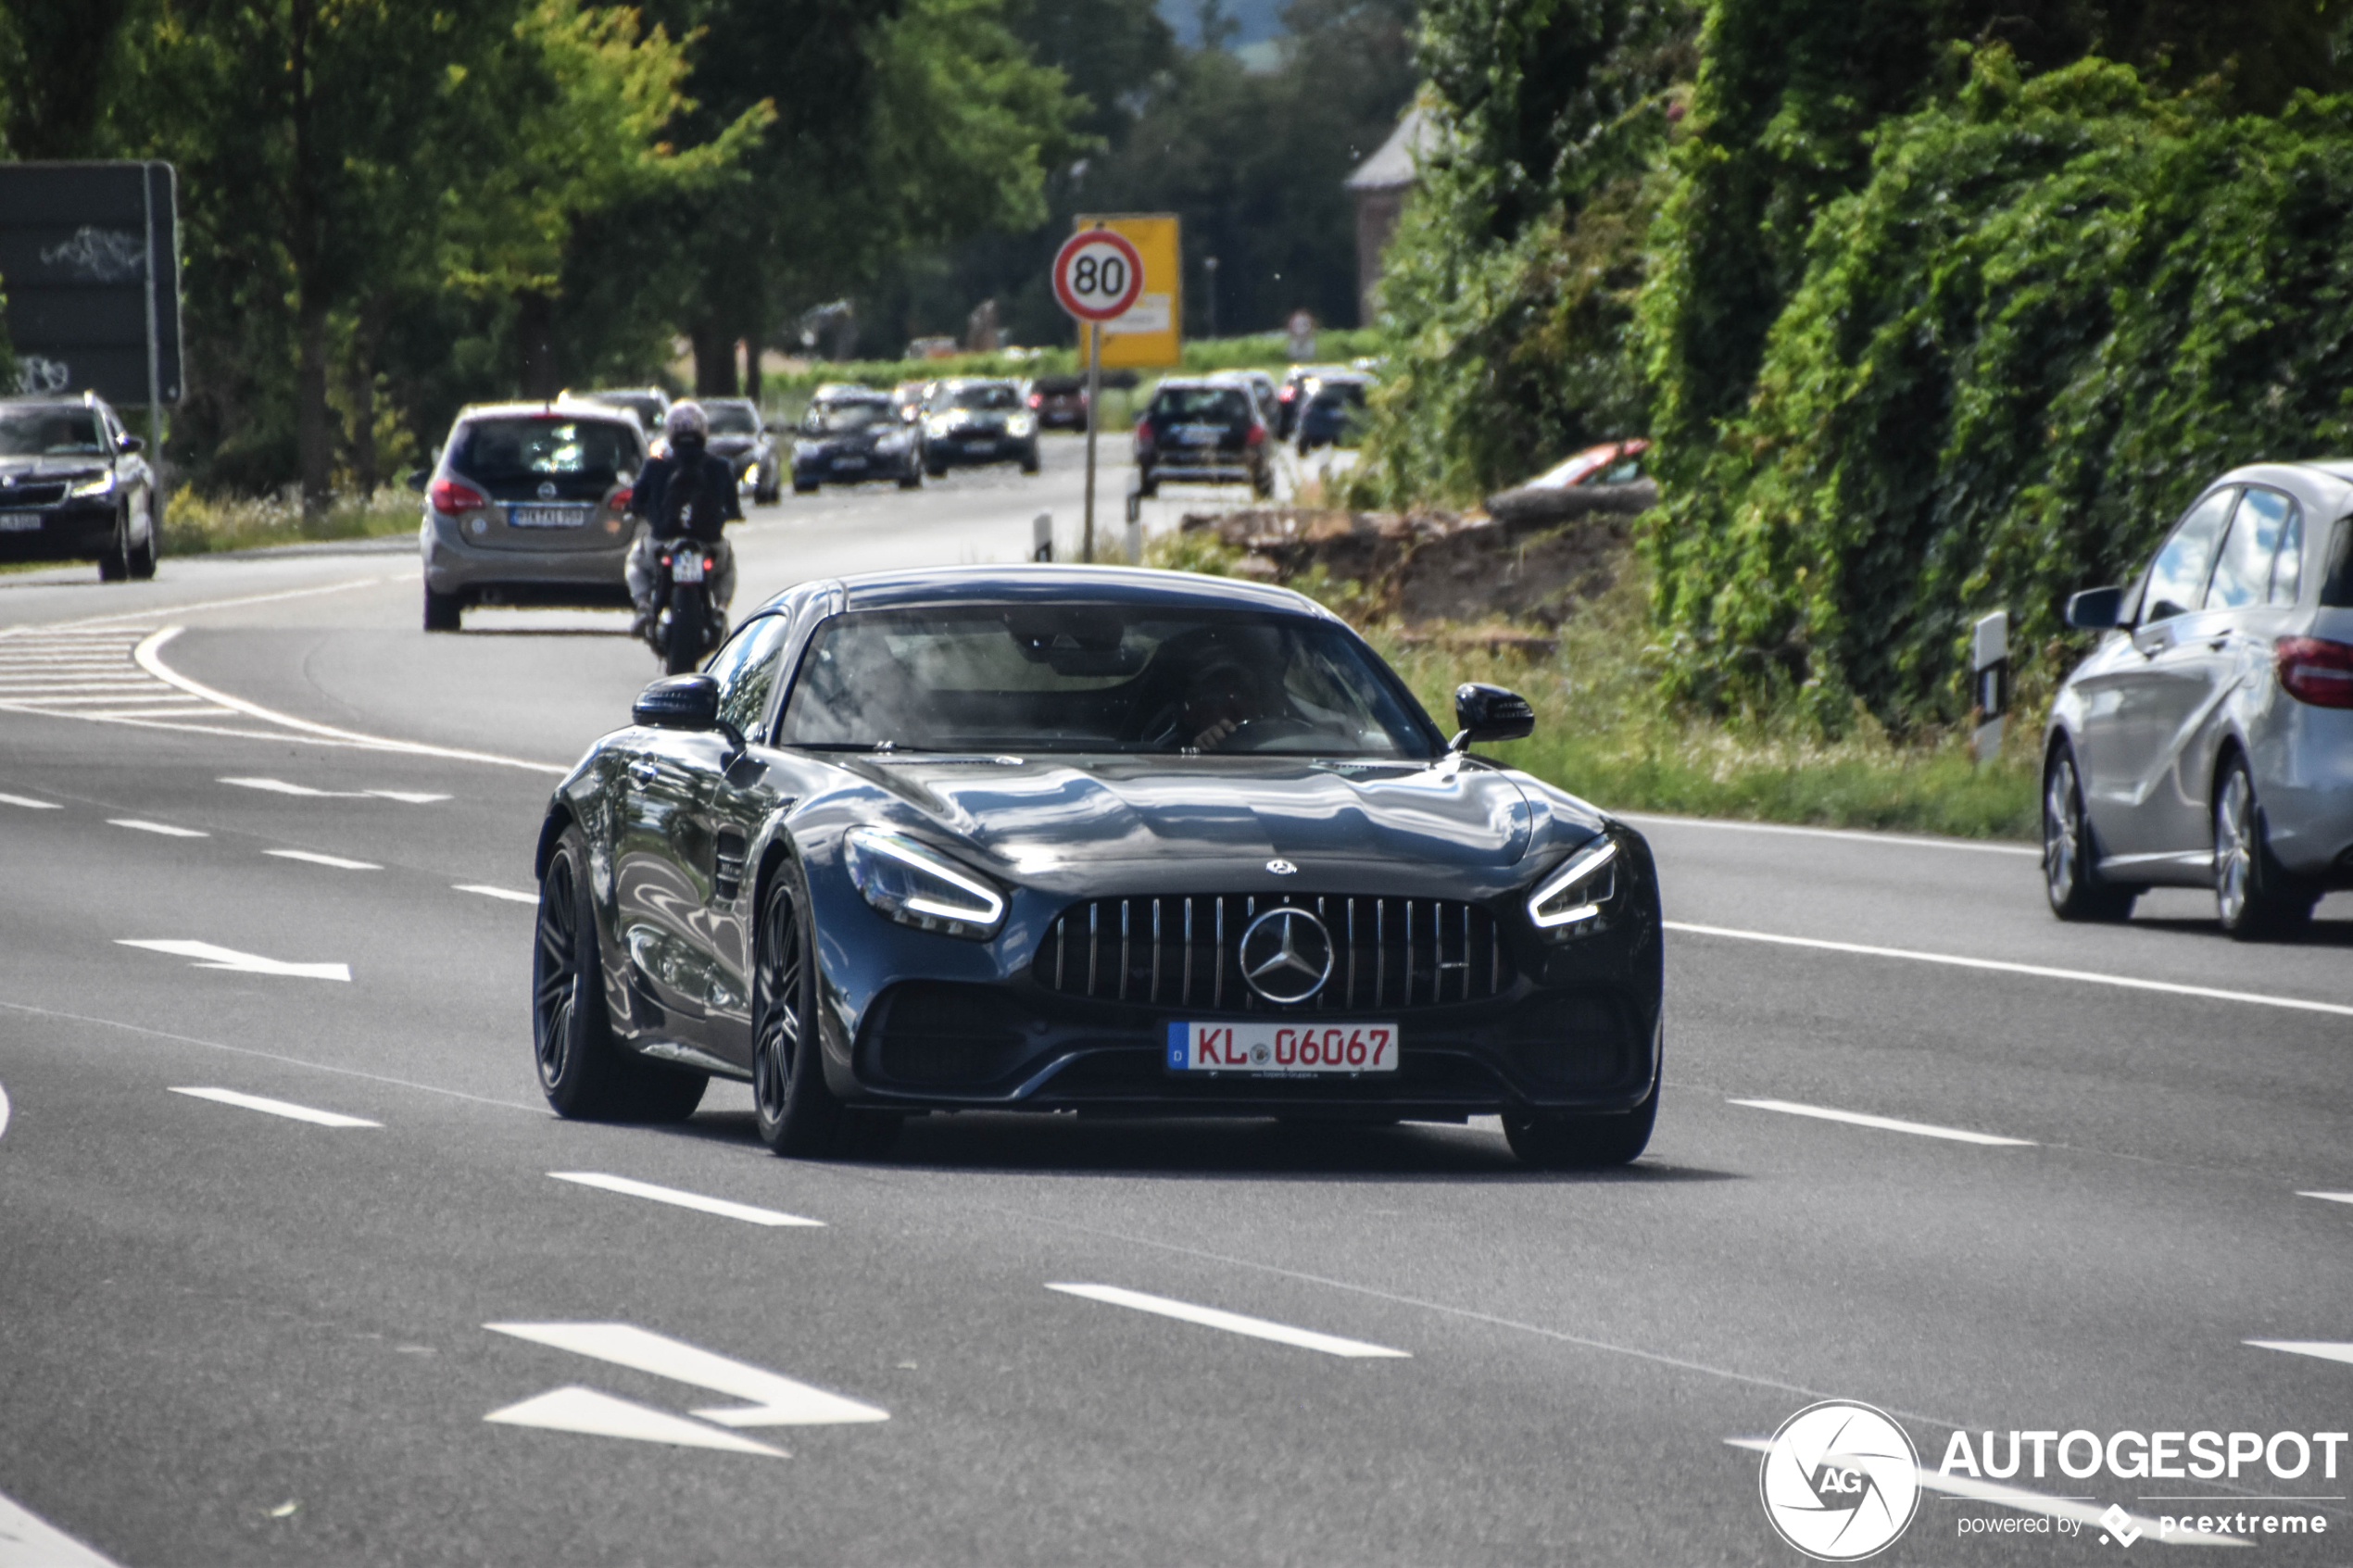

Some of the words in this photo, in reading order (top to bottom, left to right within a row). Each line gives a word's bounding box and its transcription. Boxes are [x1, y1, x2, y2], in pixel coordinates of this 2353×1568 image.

[1074, 255, 1124, 295] 80
[1174, 1050, 1182, 1061] D
[1199, 1028, 1248, 1064] KL
[1275, 1028, 1390, 1065] 06067
